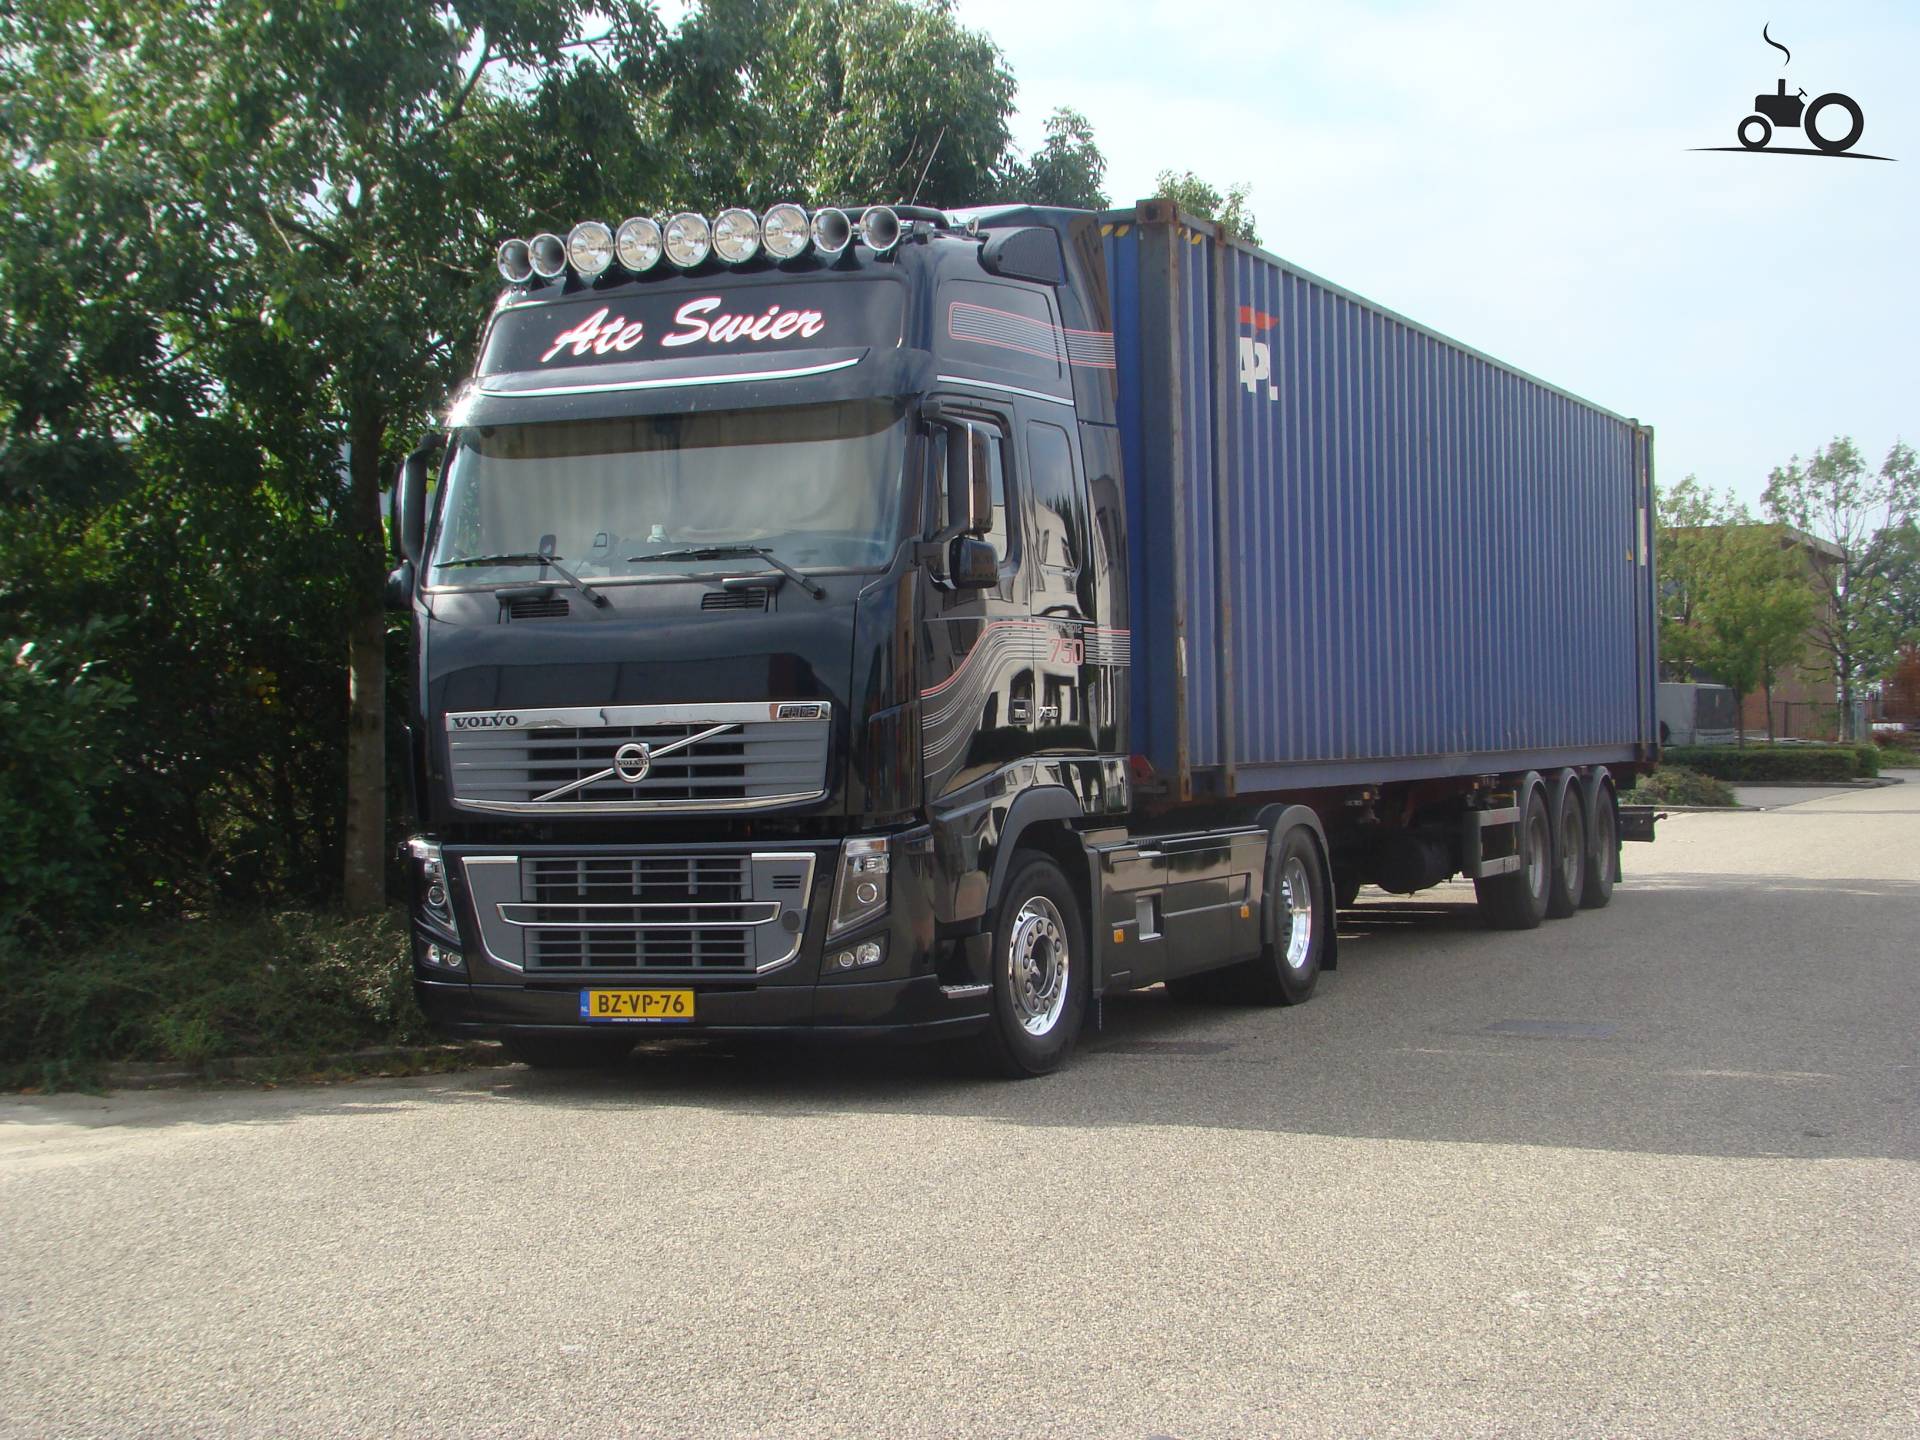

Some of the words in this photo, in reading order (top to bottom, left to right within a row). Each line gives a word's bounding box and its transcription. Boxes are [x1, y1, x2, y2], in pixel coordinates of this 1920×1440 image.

[541, 305, 643, 363] Ate
[660, 296, 825, 347] Swier
[1049, 638, 1084, 665] 750
[1038, 705, 1059, 720] 750
[452, 715, 518, 728] VOLVO
[616, 759, 648, 767] VOLVO
[597, 994, 685, 1013] BZ-VP-76
